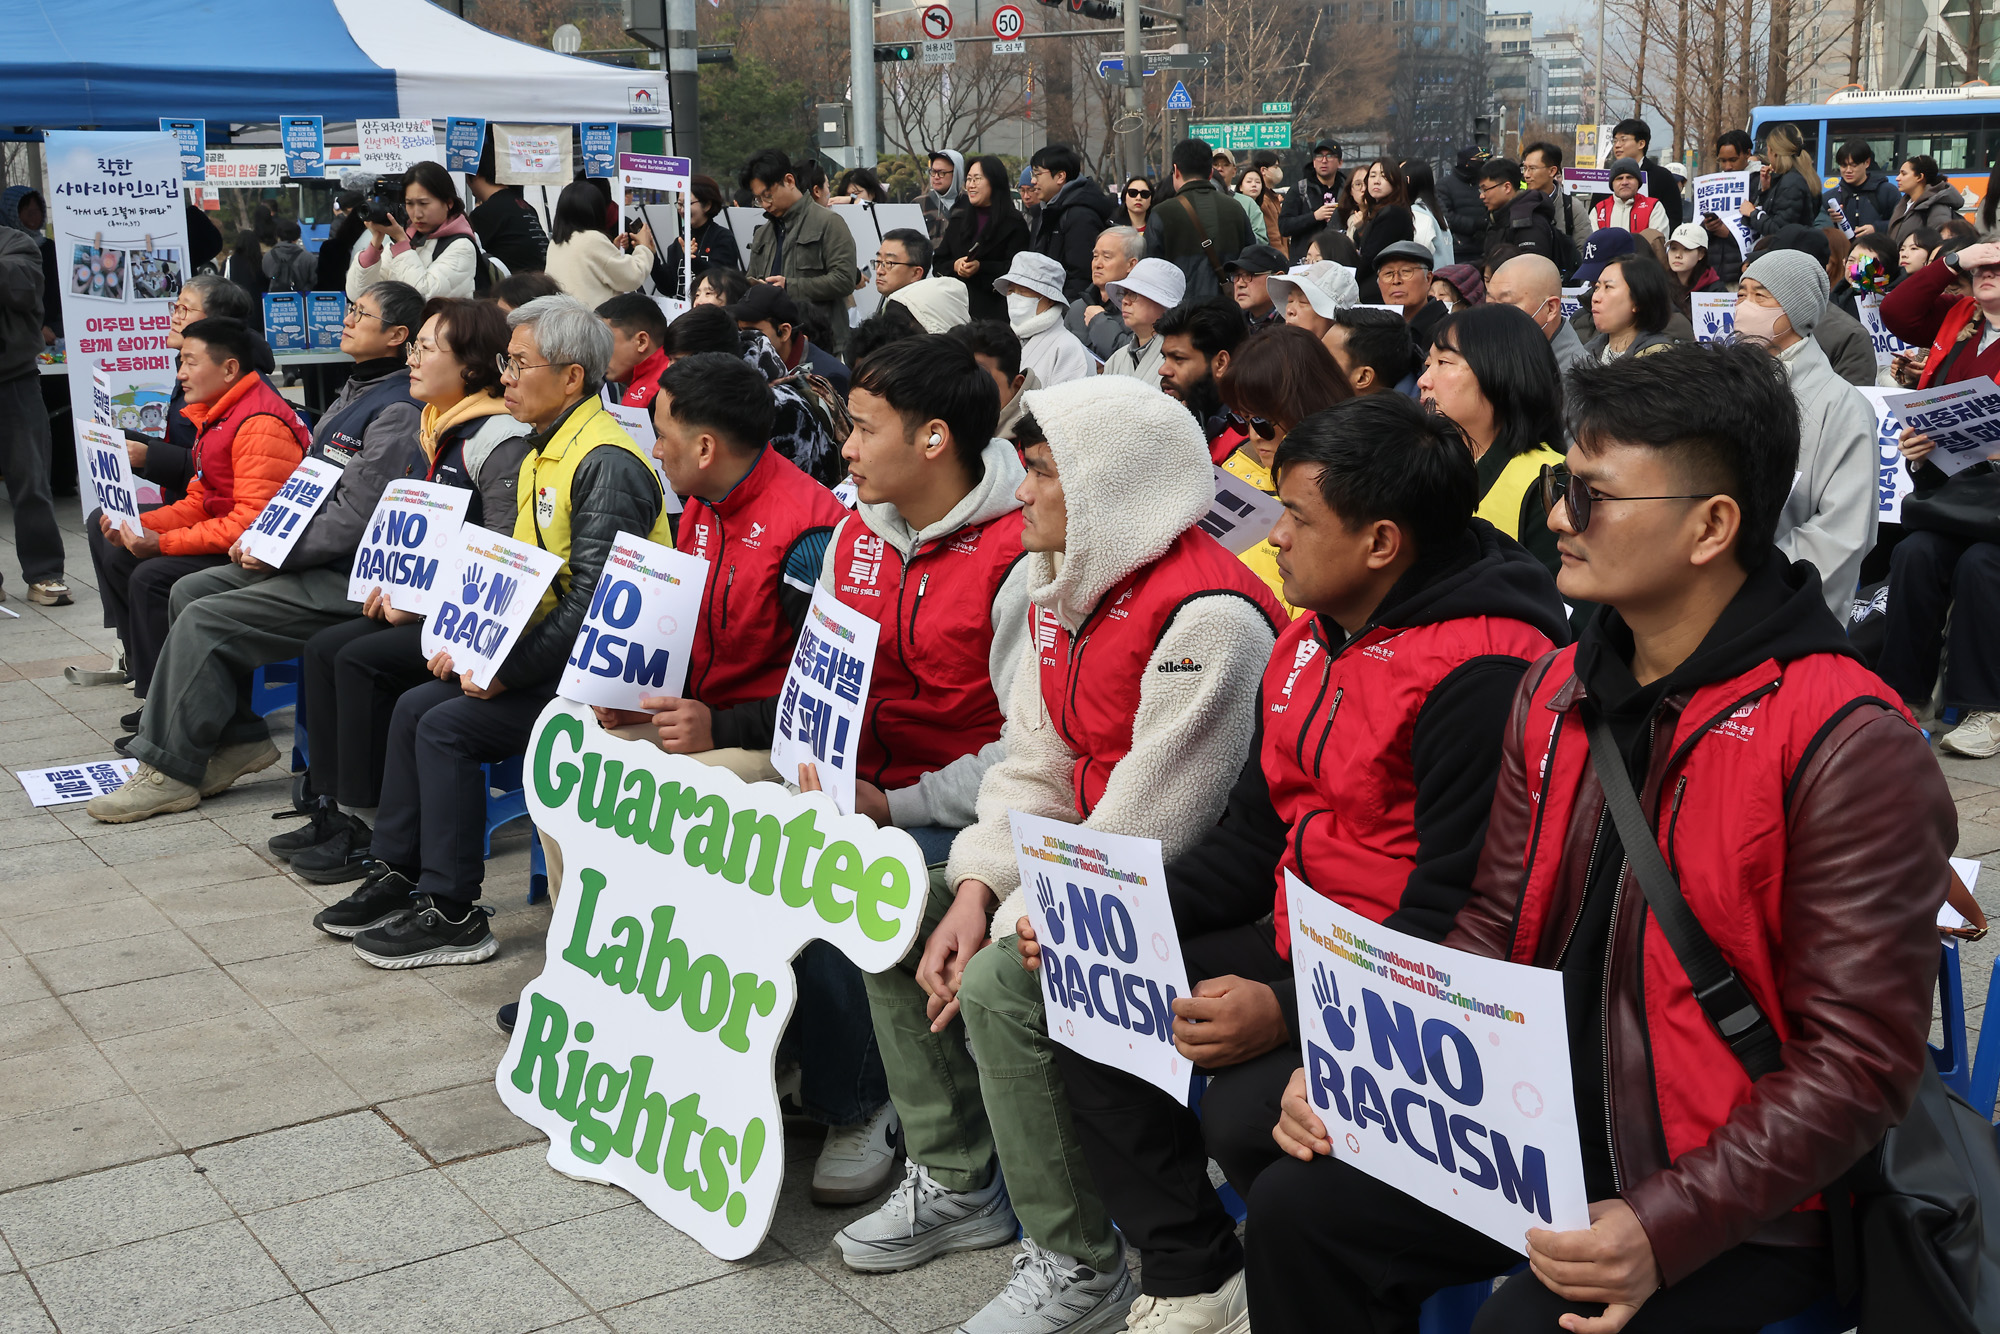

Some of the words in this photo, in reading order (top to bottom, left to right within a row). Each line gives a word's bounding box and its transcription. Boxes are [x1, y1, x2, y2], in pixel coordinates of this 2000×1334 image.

[999, 14, 1018, 32] 50
[925, 43, 938, 52] 허용
[940, 42, 952, 51] 시간
[98, 158, 133, 176] 착한
[1697, 182, 1744, 198] 인종차별
[86, 318, 135, 332] 이주민
[139, 316, 170, 330] 난민
[80, 338, 112, 353] 함께
[101, 356, 170, 372] 노동하며!
[97, 450, 120, 482] NO
[417, 498, 453, 511] Discrimination
[386, 510, 428, 548] NO
[356, 548, 439, 591] RACISM
[627, 560, 680, 585] Discrimination
[632, 551, 645, 562] Day
[484, 572, 518, 617] NO
[841, 584, 859, 595] UNITE!
[795, 625, 864, 705] 인종차별
[1158, 662, 1202, 673] ellesse
[780, 676, 850, 770] 철폐!
[532, 712, 911, 942] Guarantee
[1030, 846, 1039, 859] the
[1039, 848, 1073, 867] Elimination
[1073, 858, 1079, 868] of
[1079, 859, 1099, 874] Racial
[1099, 864, 1148, 886] Discrimination
[1042, 835, 1058, 849] 2026
[1058, 839, 1097, 859] International
[1096, 849, 1108, 865] Day
[1066, 882, 1138, 964] NO
[562, 868, 777, 1054] Labor
[1300, 919, 1309, 936] for
[1310, 926, 1323, 946] the
[1324, 936, 1376, 973] Elimination
[1377, 962, 1389, 979] of
[1390, 968, 1426, 994] Racial
[1427, 981, 1525, 1024] Discrimination
[1331, 923, 1353, 946] 2026
[1353, 935, 1425, 975] International
[1427, 964, 1451, 987] Day
[1041, 944, 1178, 1046] RACISM
[1362, 987, 1484, 1106] NO
[510, 992, 766, 1228] Rights!
[1308, 1040, 1552, 1224] RACISM
